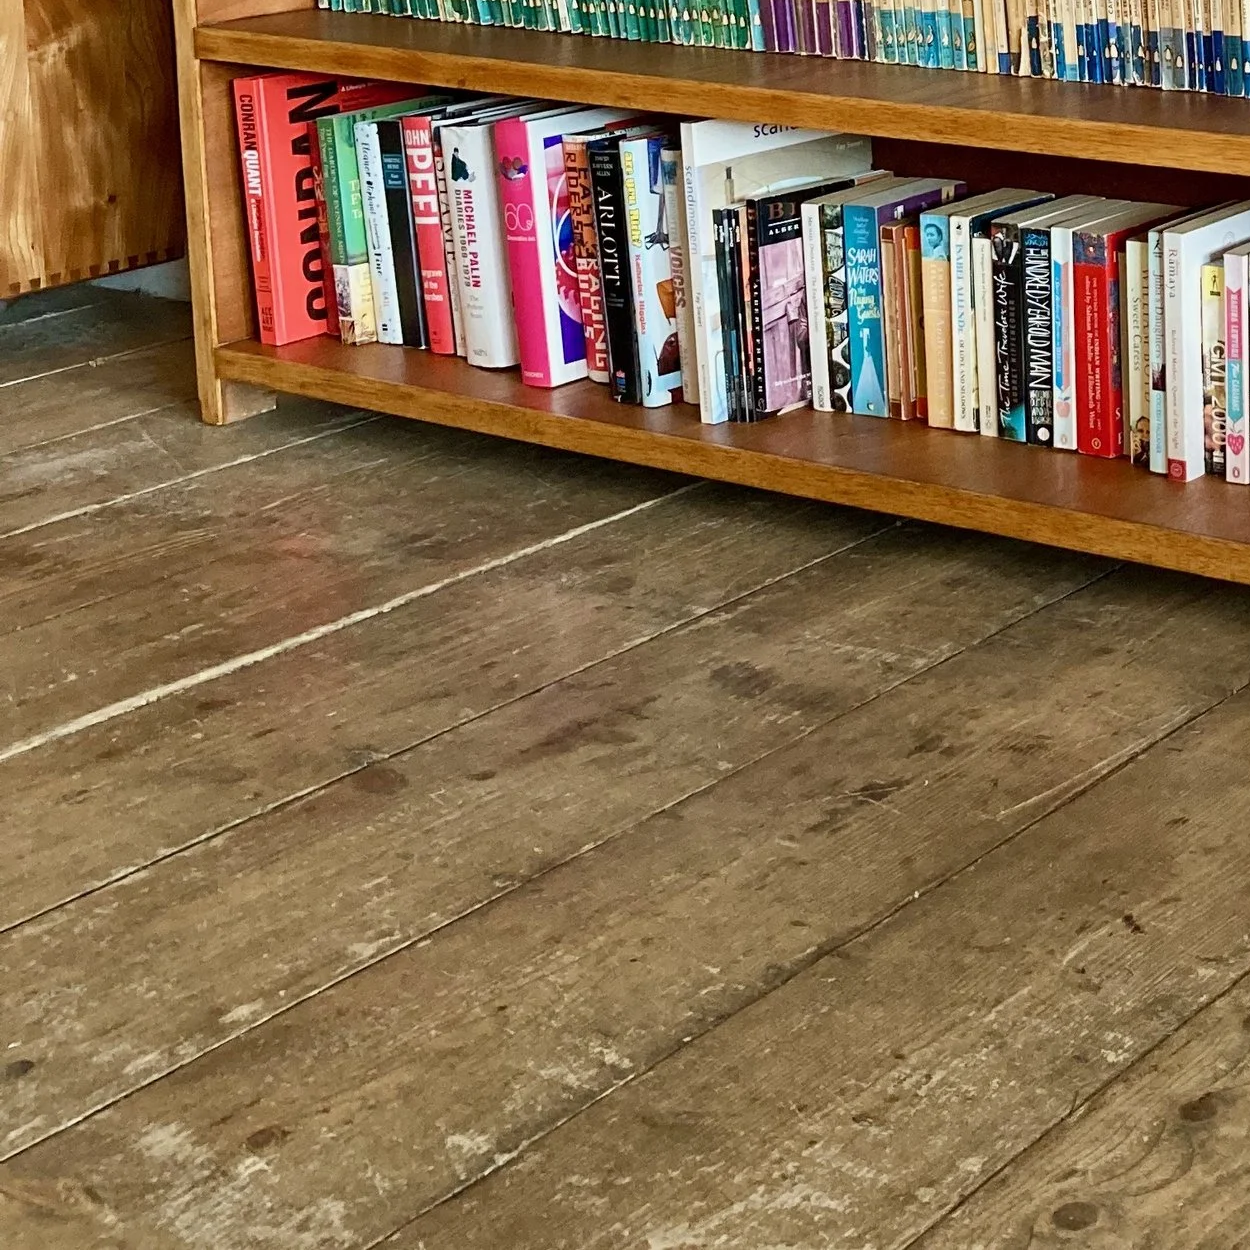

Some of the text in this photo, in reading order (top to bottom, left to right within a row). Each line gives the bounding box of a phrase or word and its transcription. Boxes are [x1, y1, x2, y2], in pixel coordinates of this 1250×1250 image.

[239, 94, 263, 197] CONRAN QUANT
[454, 189, 466, 230] DIARIES
[564, 151, 594, 234] EASY RIDERS
[685, 165, 698, 255] scandimodern
[462, 189, 481, 288] MICHAEL PALIN
[597, 185, 622, 287] ARLOTT
[847, 247, 877, 267] SARAH
[671, 245, 686, 309] VOICES
[848, 266, 879, 288] WATERS
[955, 244, 965, 335] ISABEL ALLENDE
[993, 270, 1015, 306] Wife
[1167, 249, 1178, 298] Ramaya
[577, 256, 607, 368] RAGING BULLS
[753, 282, 764, 394] ALBERT FRENCH
[1132, 297, 1142, 372] Sweet Caress
[1153, 306, 1165, 359] Daughters
[998, 361, 1011, 399] Time
[1028, 350, 1052, 390] MAN
[997, 395, 1012, 428] The
